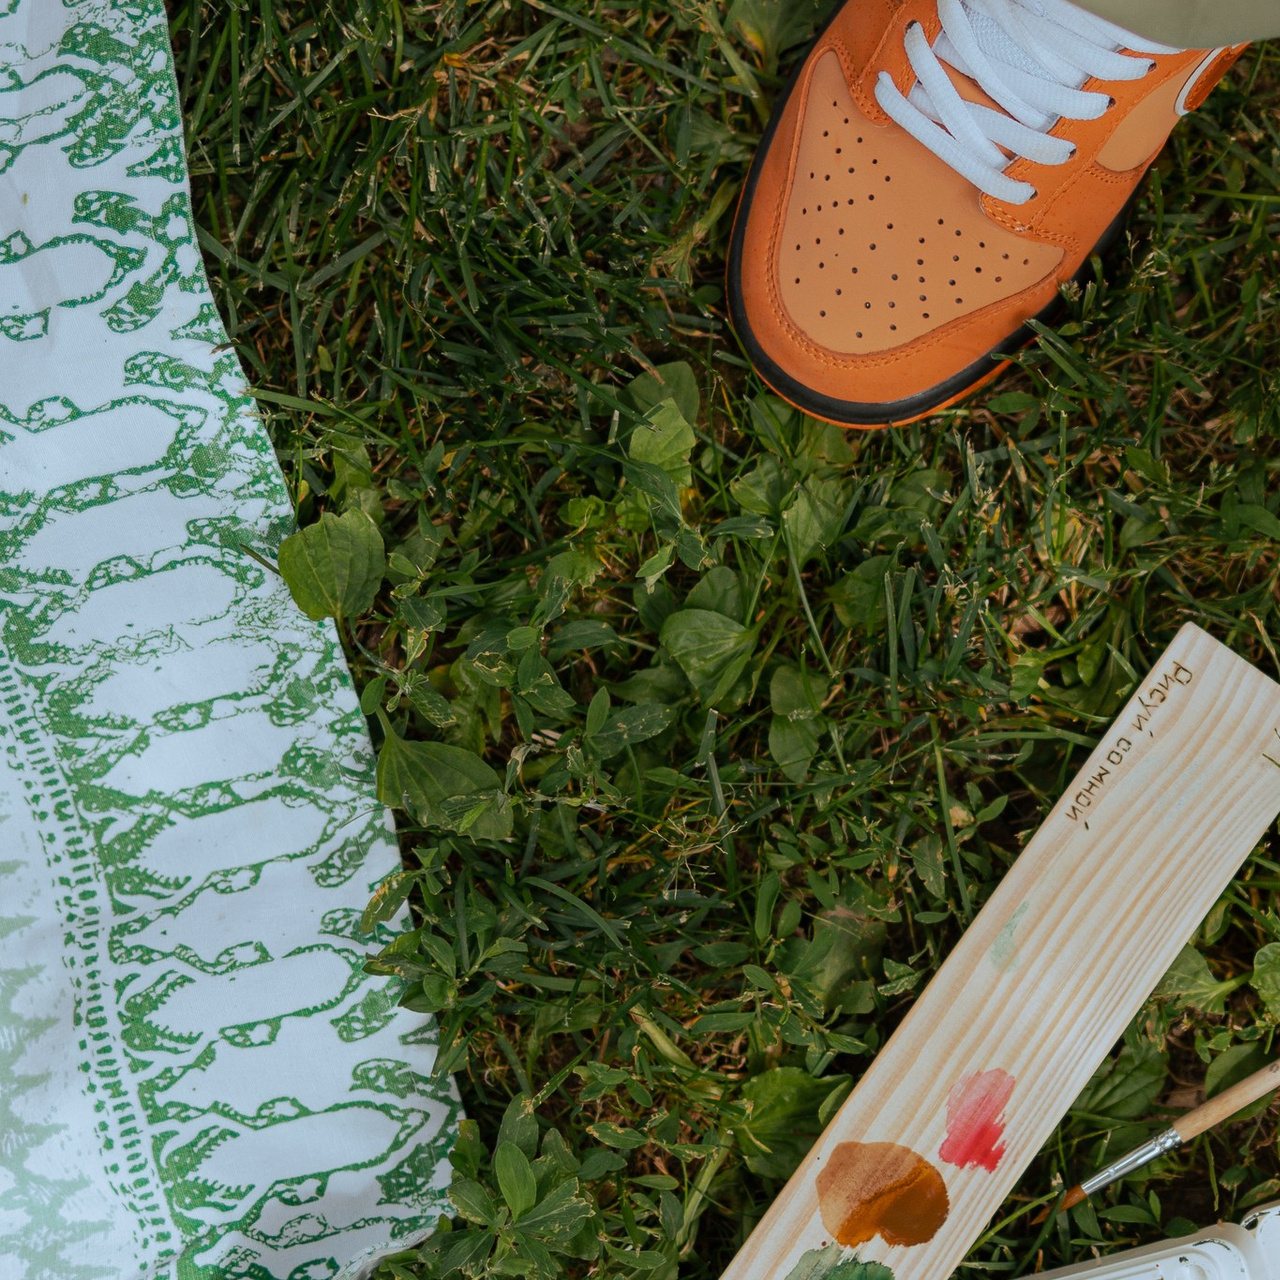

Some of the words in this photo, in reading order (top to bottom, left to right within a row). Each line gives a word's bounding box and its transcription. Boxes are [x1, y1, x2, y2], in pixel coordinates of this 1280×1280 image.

[1131, 661, 1193, 738] Рисуй
[1106, 737, 1132, 766] со
[1065, 765, 1111, 831] мной
